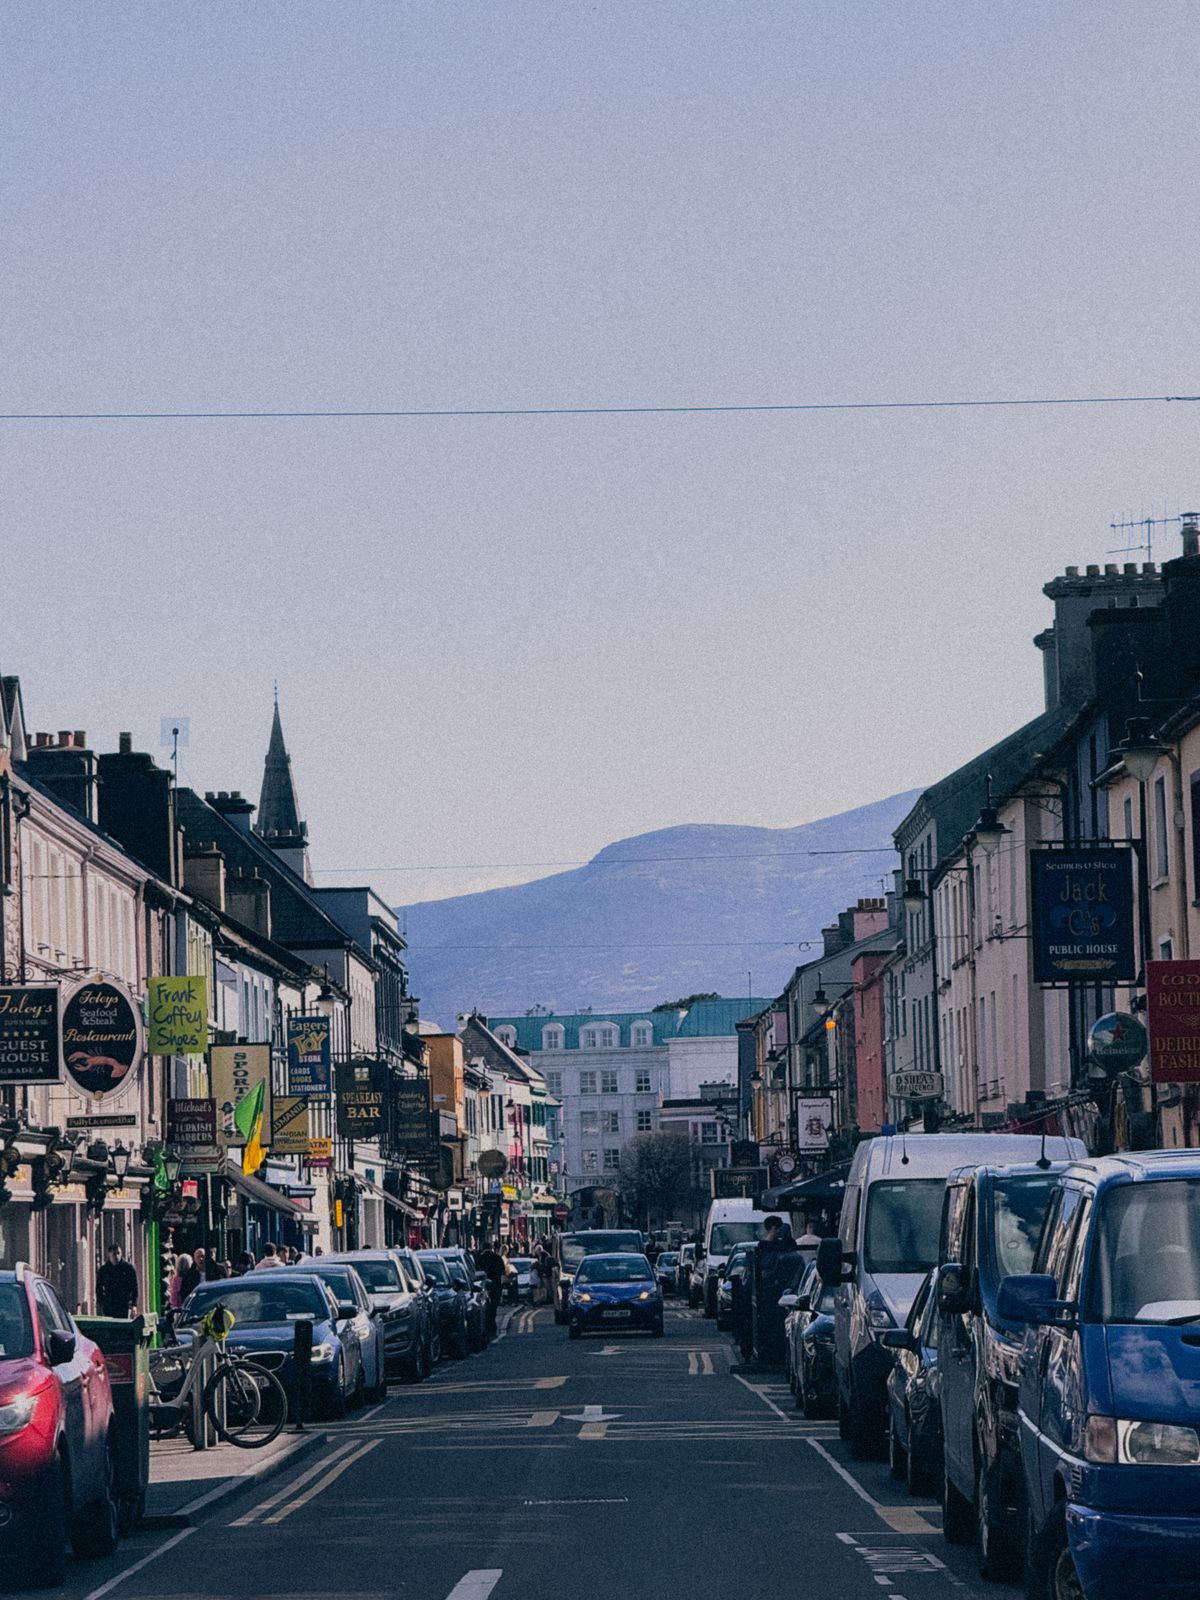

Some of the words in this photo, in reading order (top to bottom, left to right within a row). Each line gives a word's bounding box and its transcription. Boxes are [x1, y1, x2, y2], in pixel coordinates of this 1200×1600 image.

[1060, 873, 1108, 902] Jack
[1049, 945, 1083, 955] PUBLIC
[1086, 944, 1118, 954] HOUSE
[157, 981, 196, 1003] Frank
[0, 993, 53, 1018] Foley's
[80, 1008, 118, 1018] Seafood
[153, 1004, 202, 1032] Coffey
[289, 1020, 328, 1034] Eagers
[64, 1028, 135, 1042] Restaurant
[157, 1028, 199, 1047] Shoes
[0, 1040, 48, 1051] GUEST
[289, 1031, 328, 1055] TOY
[290, 1084, 327, 1093] STATIONERY
[341, 1092, 384, 1104] SPEAKEASY
[346, 1107, 382, 1118] BAR
[175, 1123, 213, 1133] TURKISH
[174, 1132, 213, 1142] BARBERS
